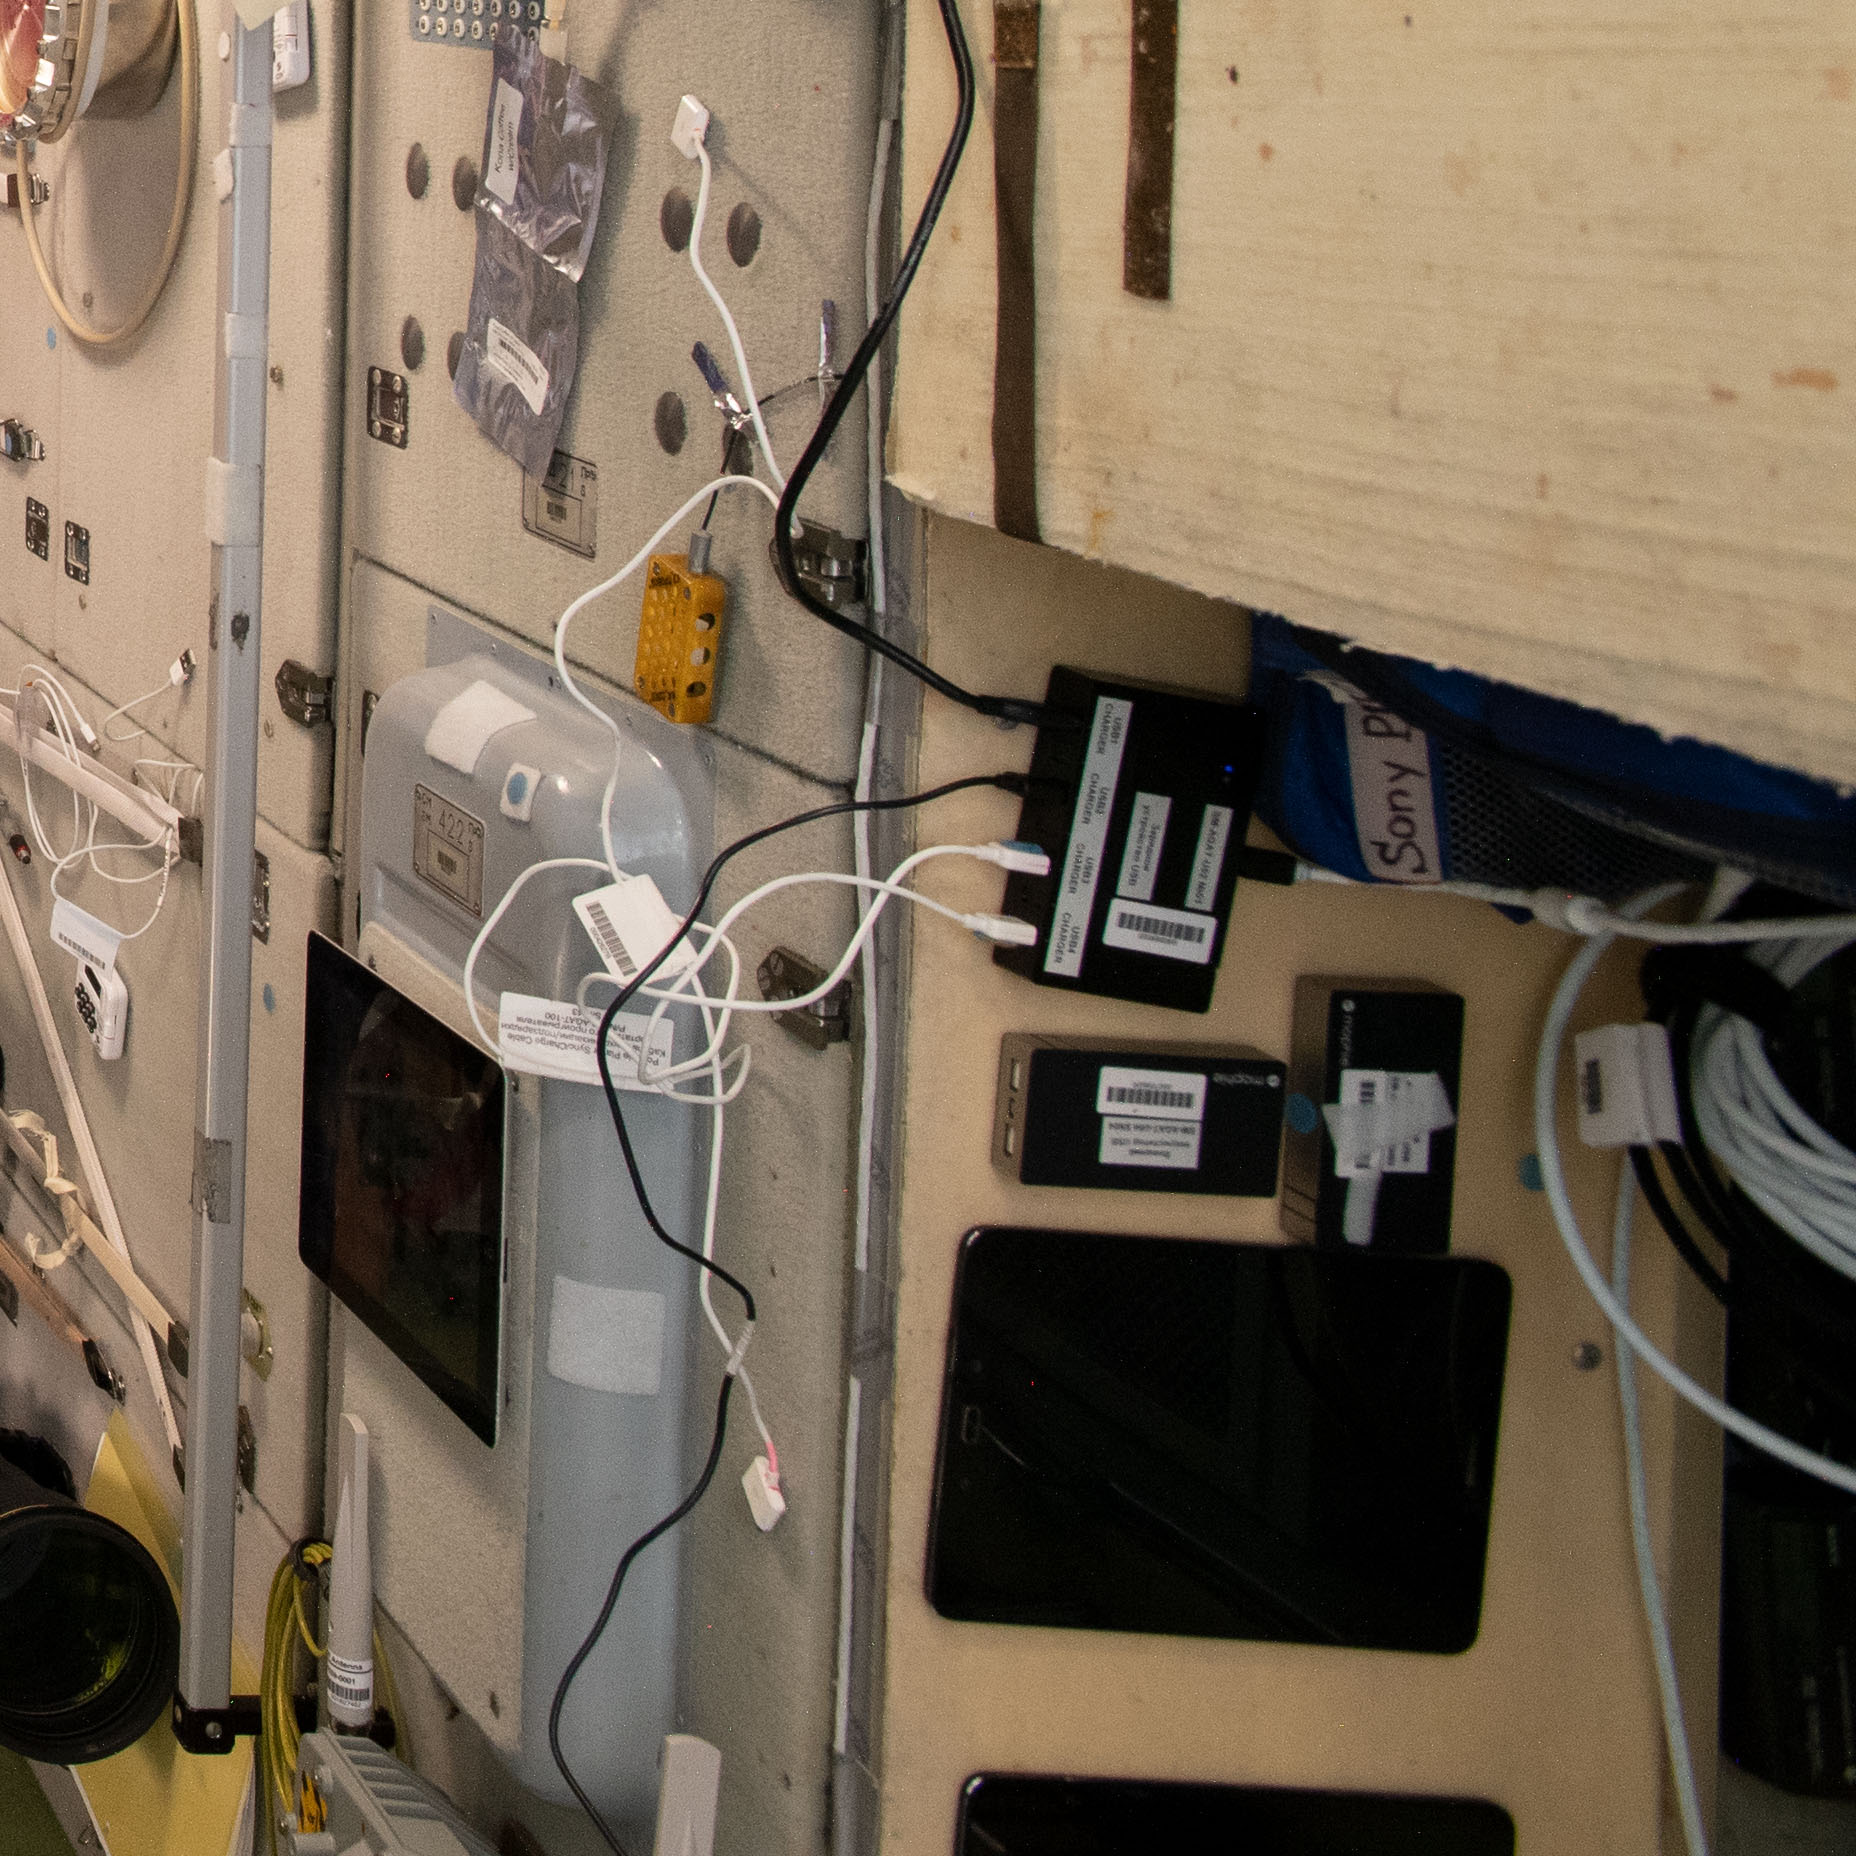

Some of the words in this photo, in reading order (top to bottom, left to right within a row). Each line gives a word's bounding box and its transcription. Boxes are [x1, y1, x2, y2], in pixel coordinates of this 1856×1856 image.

[494, 103, 509, 141] Coffee
[492, 143, 506, 173] Kona
[1094, 701, 1114, 755] CHARGER
[1108, 715, 1123, 745] USB1
[1080, 771, 1100, 825] CHARGER
[1094, 785, 1109, 816] USB2
[1369, 760, 1428, 874] Sony
[1066, 842, 1086, 895] CHARGER
[1080, 855, 1094, 885] USB3
[1127, 863, 1141, 887] USB
[1052, 911, 1072, 964] CHARGER
[1065, 925, 1081, 954] USB4
[506, 1032, 533, 1044] Cable
[514, 1014, 589, 1033] проигрывателя
[533, 1036, 591, 1054] Sync/Charge
[330, 1655, 363, 1670] Antenna
